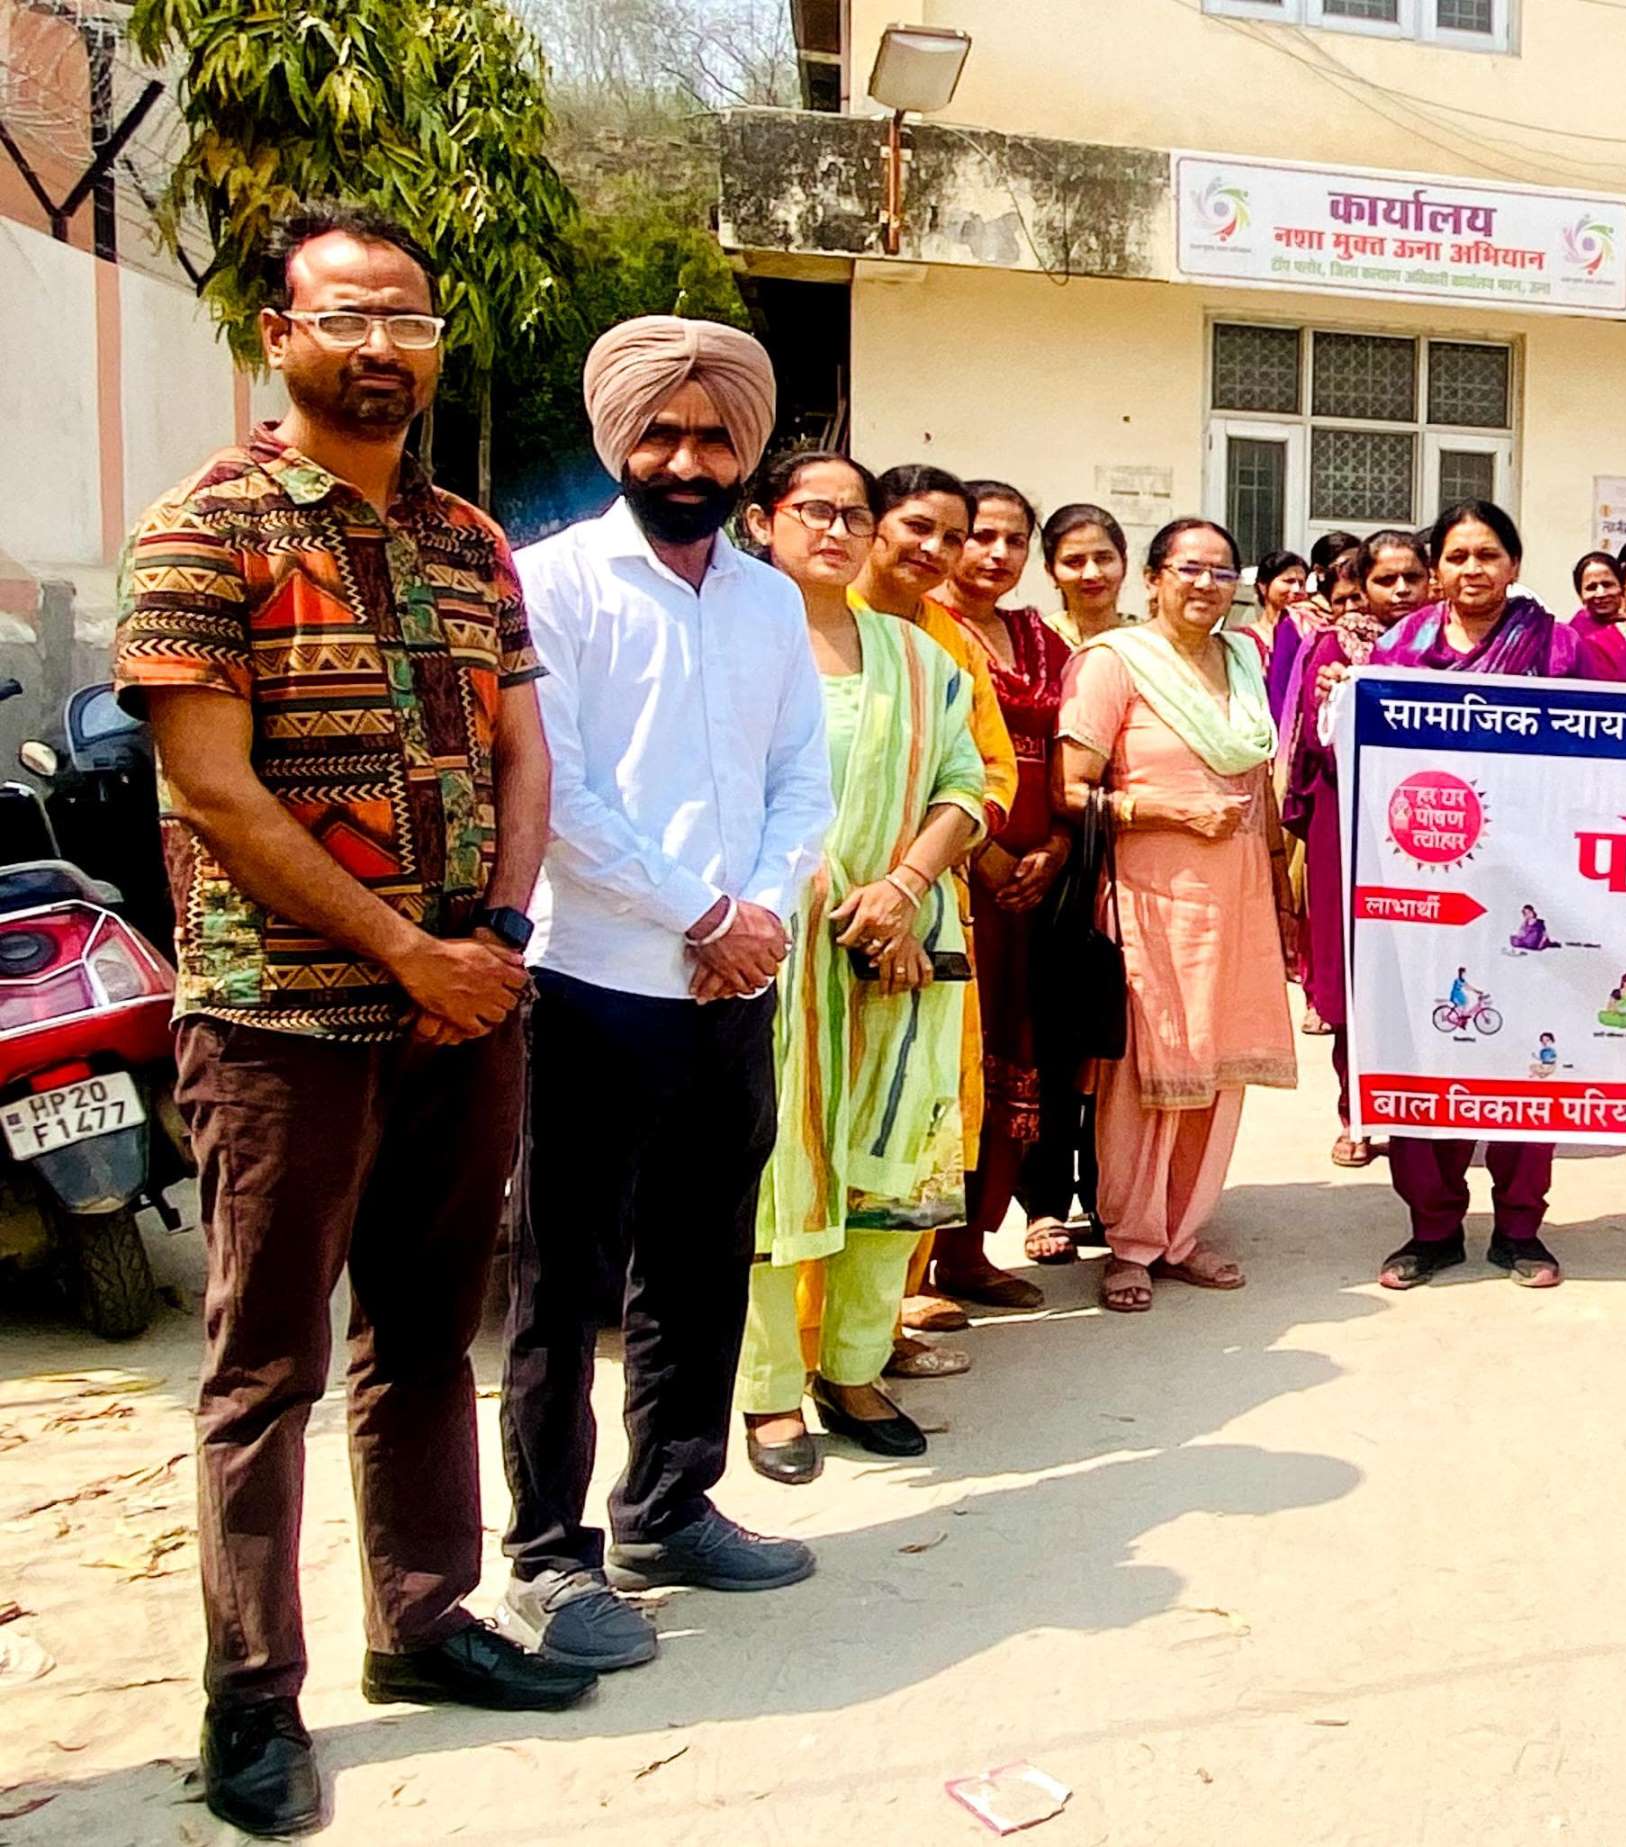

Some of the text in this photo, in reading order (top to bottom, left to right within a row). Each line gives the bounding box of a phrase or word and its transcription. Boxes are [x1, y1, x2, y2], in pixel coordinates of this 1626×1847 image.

[1328, 189, 1497, 238] कार्यालय
[1273, 226, 1546, 270] नशा मुक्त ऊना अभियान
[1381, 694, 1541, 736] सामाजिक
[1549, 707, 1626, 742] न्याय
[1414, 804, 1466, 828] पोषण
[1440, 789, 1468, 807] घर
[1364, 895, 1440, 919] लाभार्थी
[29, 1081, 108, 1121] HP20
[1371, 1089, 1438, 1121] बाल
[1445, 1083, 1552, 1125] विकास
[33, 1101, 125, 1148] F1477
